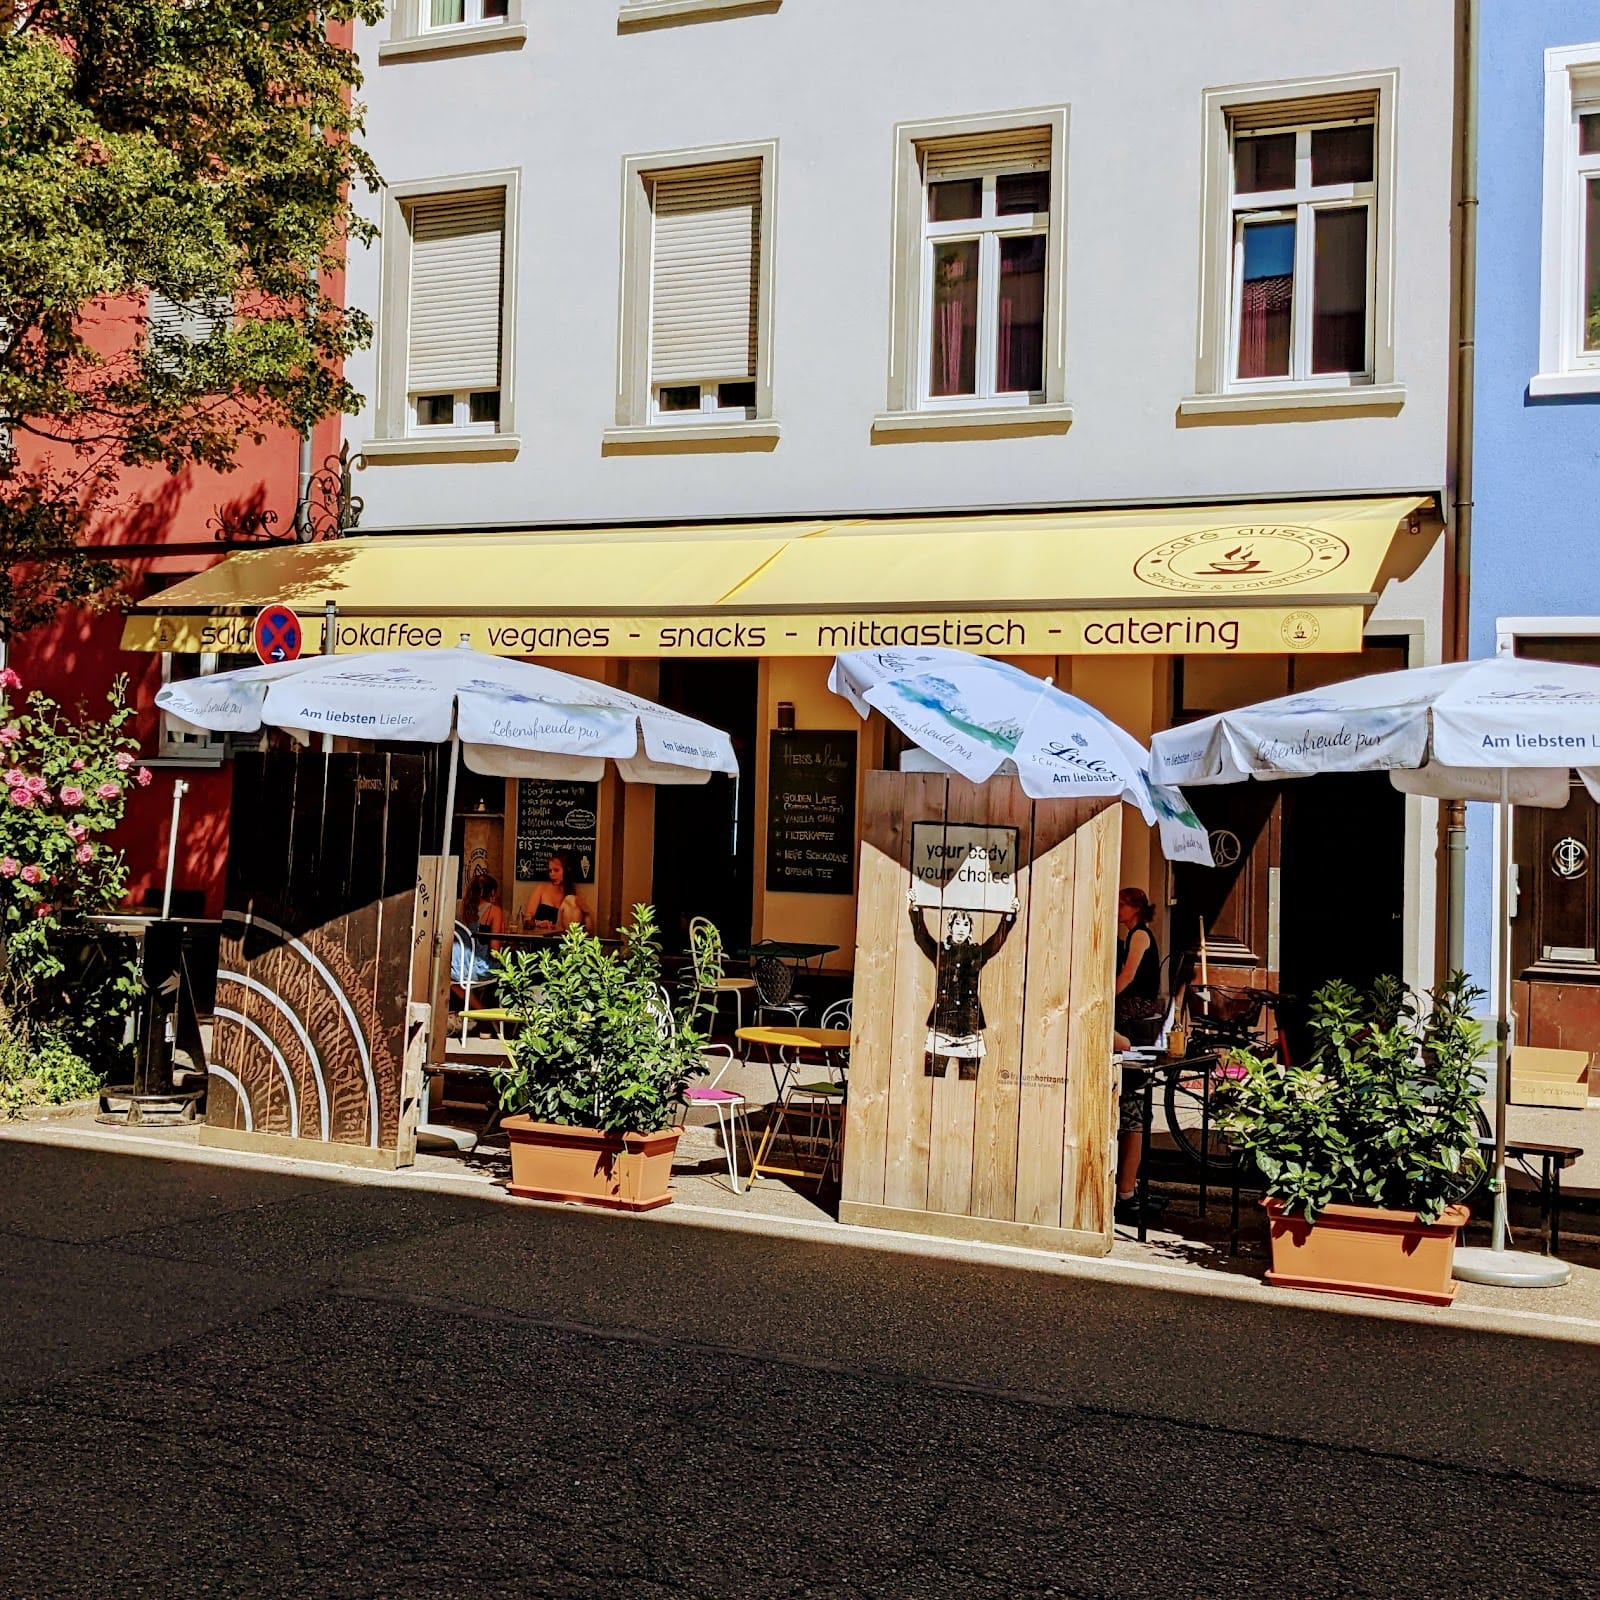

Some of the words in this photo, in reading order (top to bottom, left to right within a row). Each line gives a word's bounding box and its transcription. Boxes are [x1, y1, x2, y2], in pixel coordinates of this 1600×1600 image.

[1157, 531, 1219, 557] café
[1237, 527, 1344, 552] auszeit
[1147, 571, 1203, 590] snacks
[1232, 568, 1324, 590] catering
[202, 623, 252, 646] sala
[488, 626, 611, 653] veganes
[659, 623, 767, 648] snacks
[1084, 616, 1240, 650] catering
[300, 707, 322, 720] Am
[326, 710, 376, 725] liebsten
[380, 713, 416, 725] Lieler.
[489, 719, 576, 740] Lebensfreude
[577, 728, 602, 741] pur
[884, 705, 955, 747] Lebensfreude
[950, 741, 974, 761] pur
[1255, 726, 1351, 762] Lebensfreude
[1354, 734, 1382, 753] pur
[1481, 734, 1510, 748] Am
[1516, 733, 1586, 748] liebsten
[1053, 773, 1071, 783] Am
[782, 793, 812, 803] GOLDEN
[519, 840, 533, 851] EIS
[927, 843, 965, 858] your
[969, 843, 1008, 864] body
[816, 868, 834, 879] TEE
[917, 866, 955, 882] your
[958, 866, 1011, 885] choice
